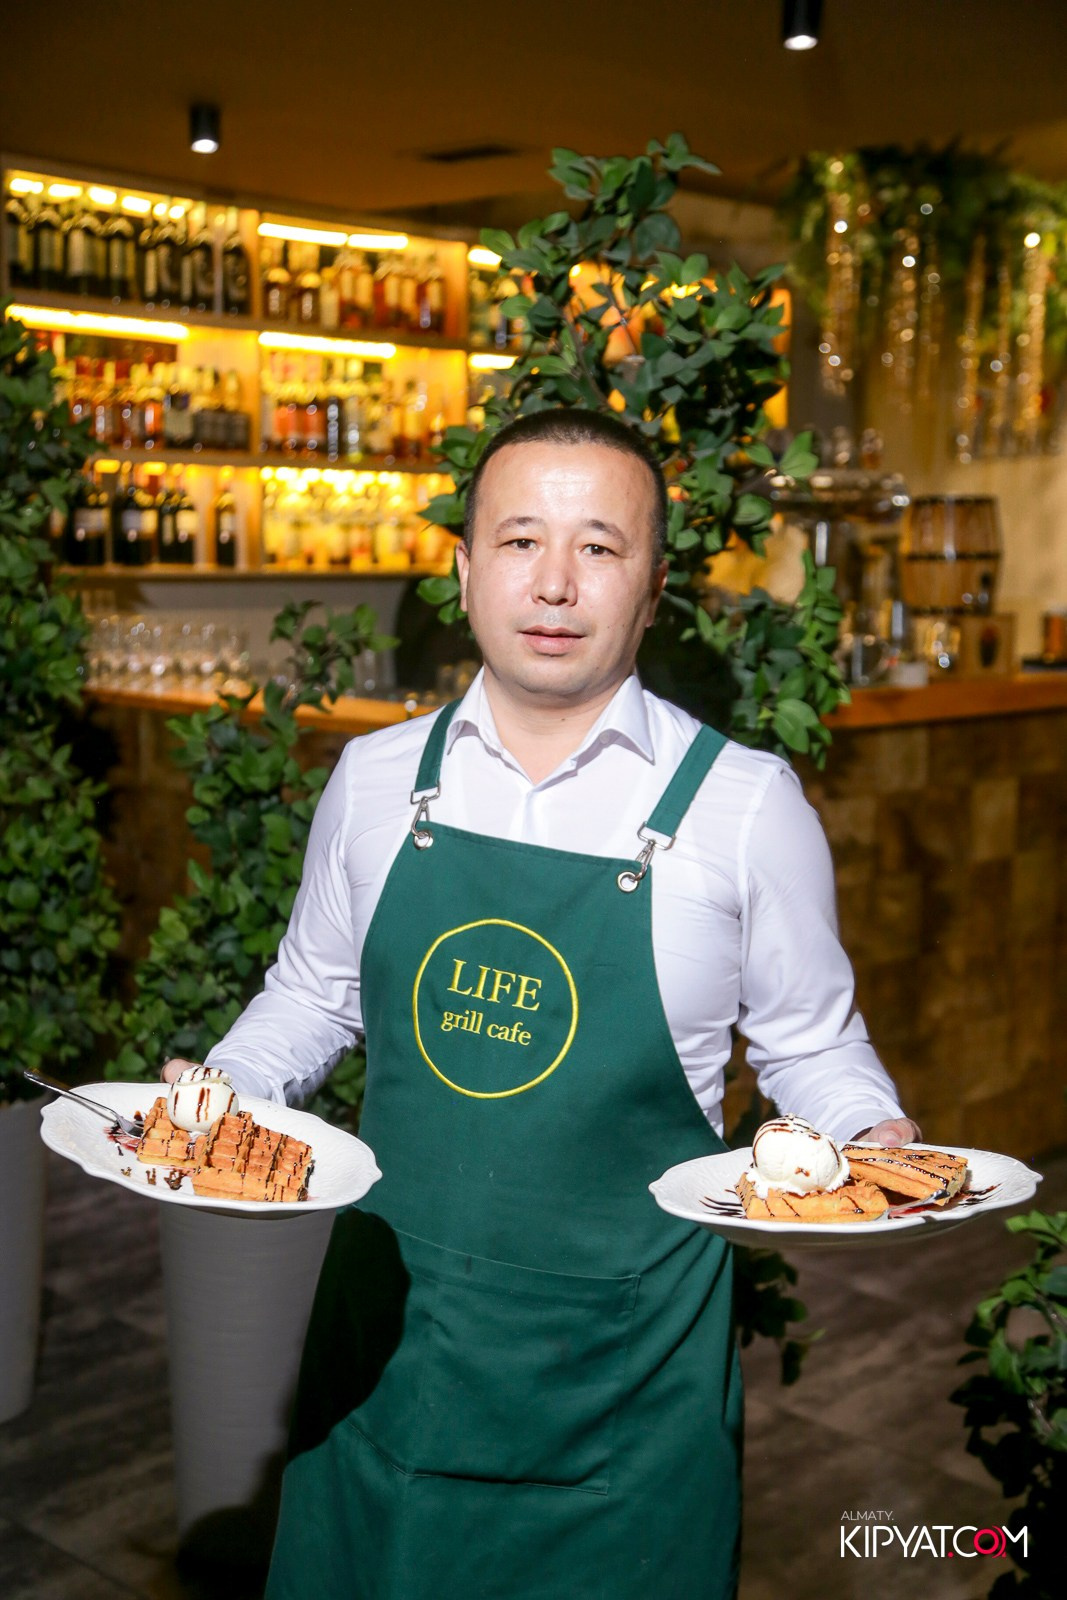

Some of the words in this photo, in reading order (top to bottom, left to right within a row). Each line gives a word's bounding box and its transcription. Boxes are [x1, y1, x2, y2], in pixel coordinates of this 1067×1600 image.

[447, 958, 542, 1011] LIFE
[441, 1009, 484, 1034] grill
[487, 1022, 532, 1046] cafe
